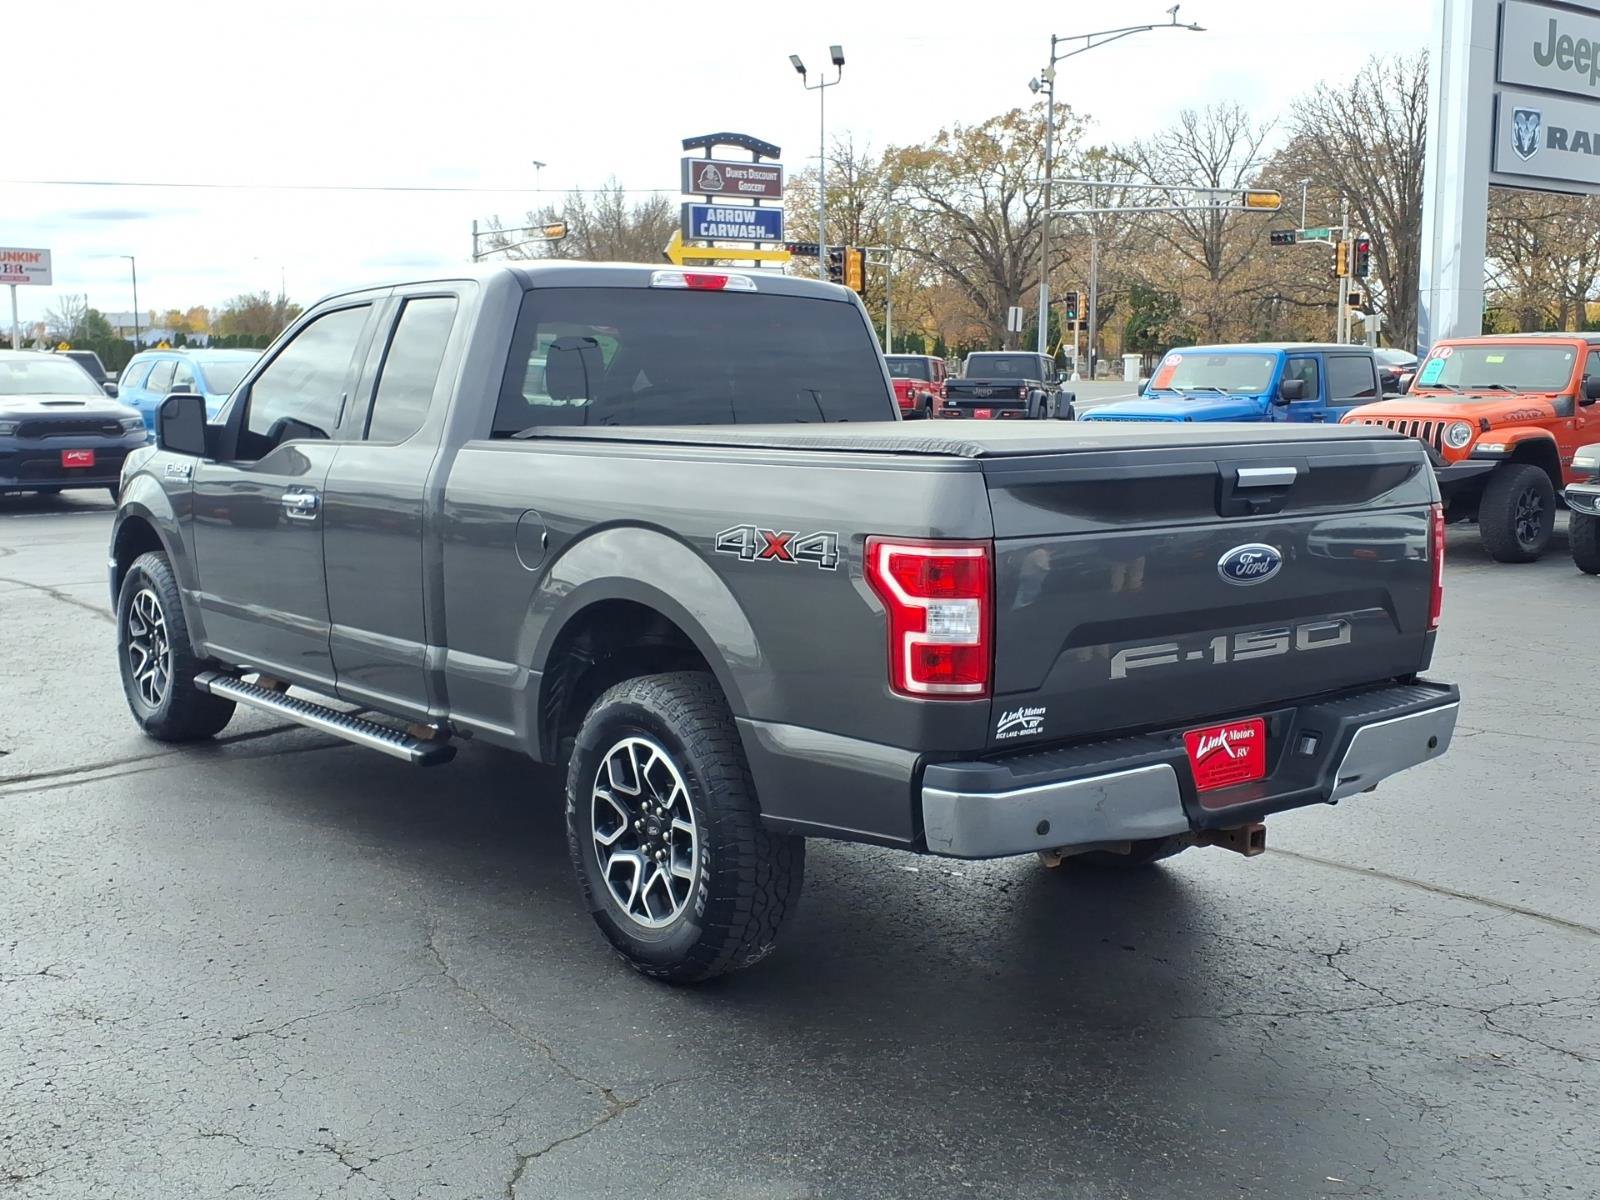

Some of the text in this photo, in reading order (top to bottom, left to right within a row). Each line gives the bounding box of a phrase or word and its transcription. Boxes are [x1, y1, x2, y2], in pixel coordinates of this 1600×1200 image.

[1547, 126, 1600, 156] RA
[748, 168, 778, 181] DISCOUNT
[738, 180, 766, 192] GROCERY
[706, 208, 757, 222] ARROW
[1235, 552, 1270, 577] Ford
[1109, 618, 1351, 680] F-150
[997, 706, 1047, 728] Link Motors
[1196, 728, 1255, 760] Link Motors
[1236, 746, 1250, 758] RV
